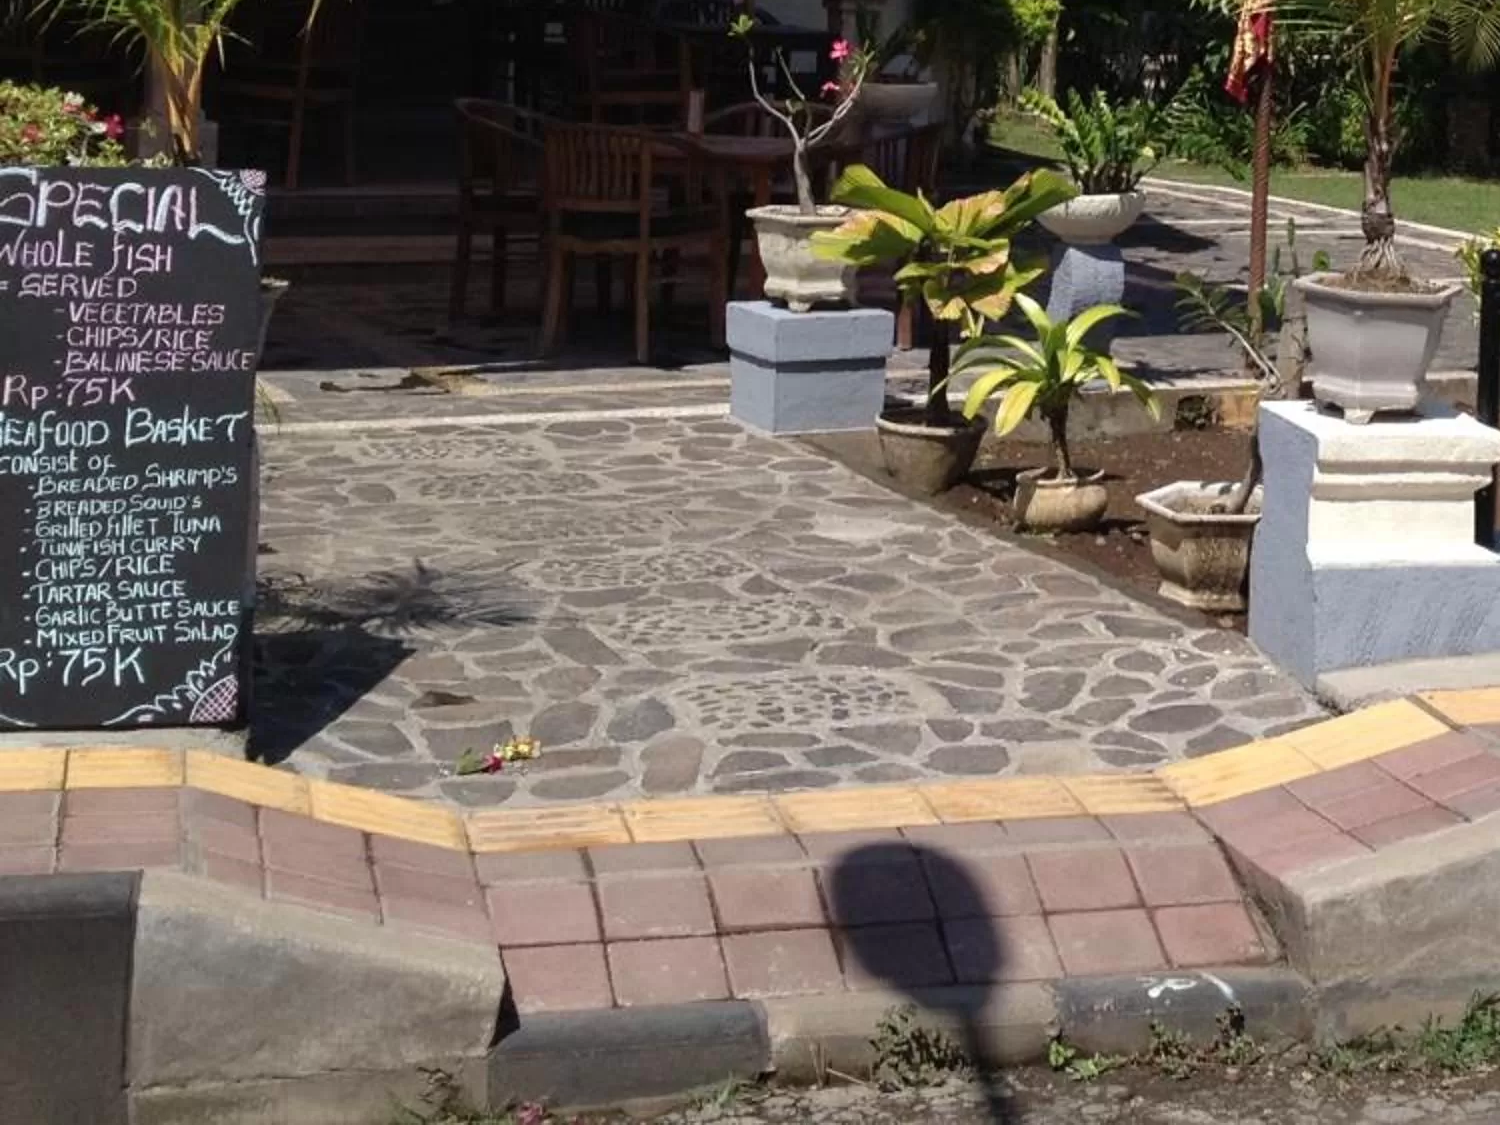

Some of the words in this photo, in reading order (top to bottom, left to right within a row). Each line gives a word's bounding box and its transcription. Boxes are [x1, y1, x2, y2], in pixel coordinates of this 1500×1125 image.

[18, 273, 138, 299] SERVED
[66, 326, 213, 350] CHIPS/RICE
[62, 350, 187, 375] BALINESE
[191, 348, 255, 372] SAUCE
[33, 476, 139, 499] BREADED
[36, 499, 127, 519] BREADED
[166, 510, 222, 534] TUNA
[130, 535, 201, 555] CURRY
[35, 555, 177, 581] CHIPS/RICE
[30, 580, 112, 604] TARTAR
[117, 579, 187, 600] SAUCE
[176, 599, 240, 618] SAUCE
[36, 627, 105, 648] MIXED
[107, 623, 168, 645] FRUIT
[173, 619, 239, 644] SALAD
